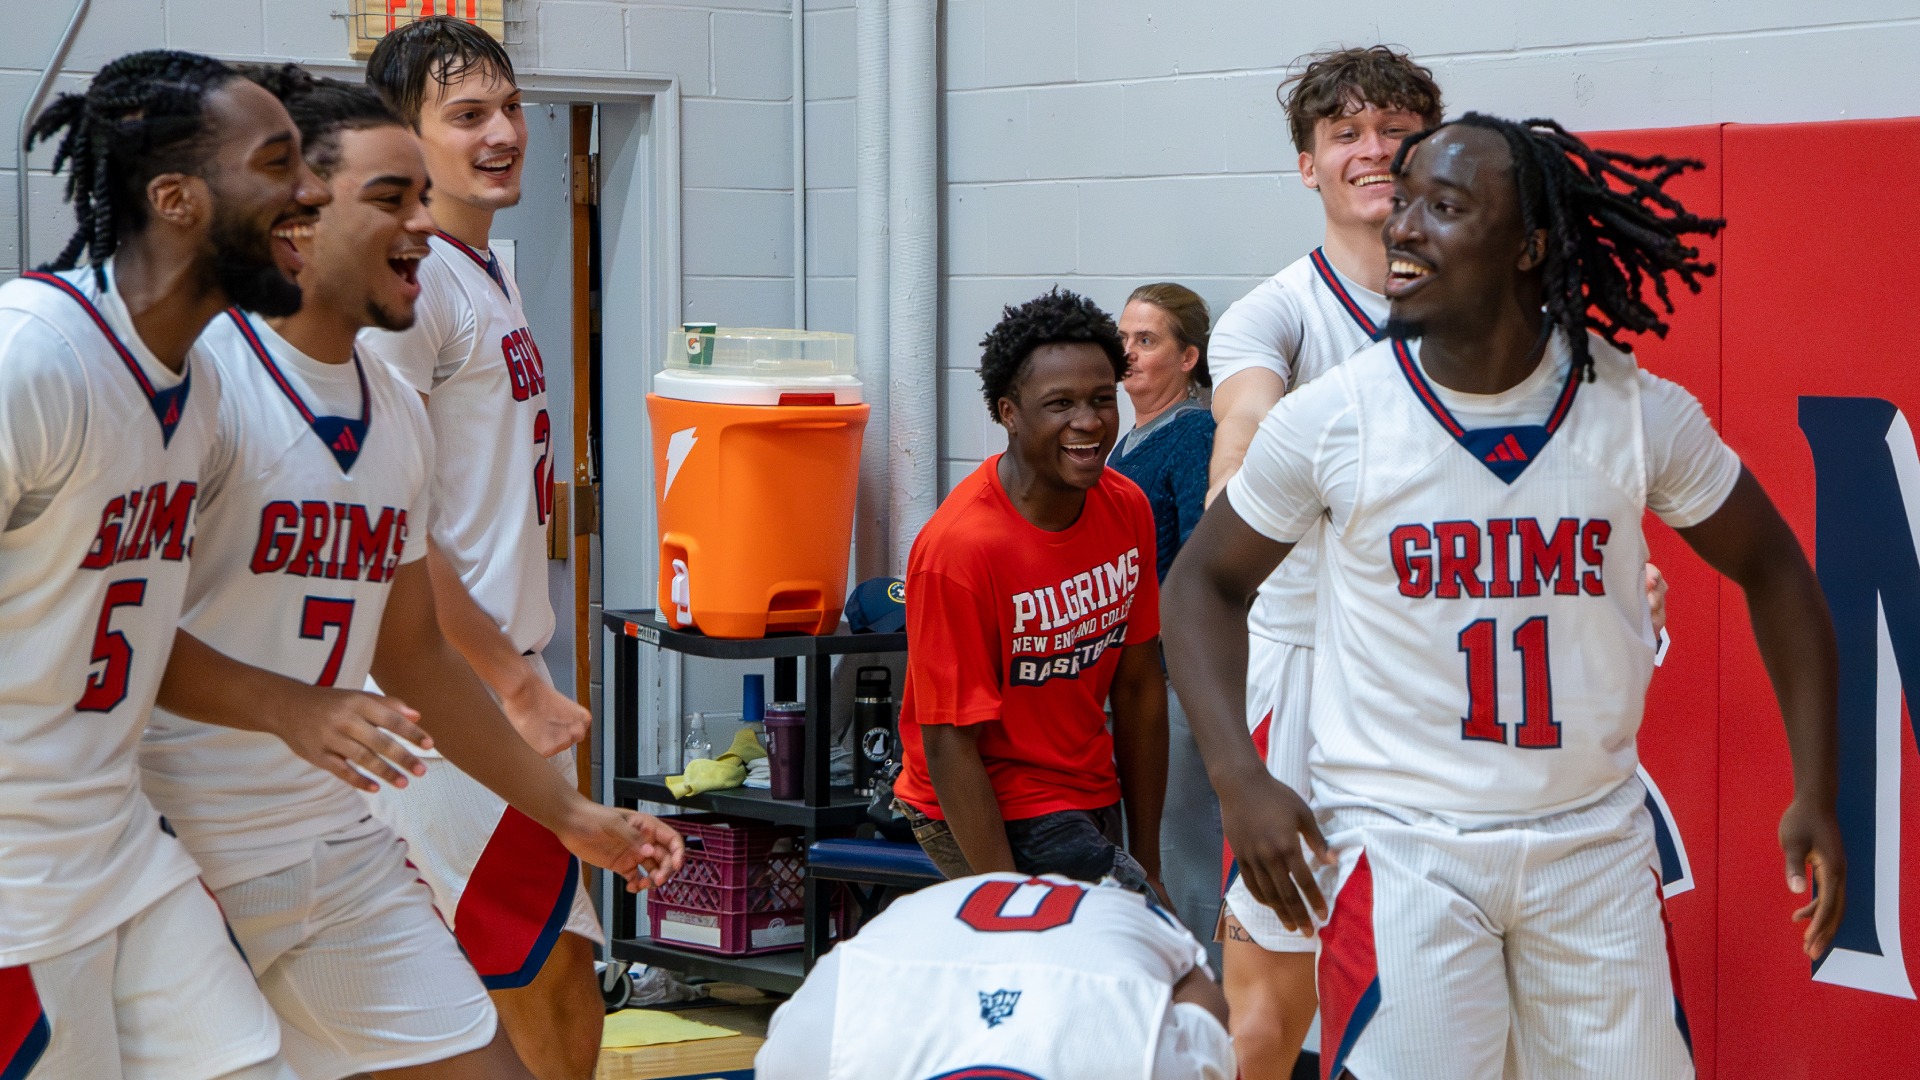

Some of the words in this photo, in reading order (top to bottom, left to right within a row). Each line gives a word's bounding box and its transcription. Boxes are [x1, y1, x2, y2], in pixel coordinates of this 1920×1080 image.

[249, 500, 409, 584] GRIMS
[1388, 516, 1612, 600] GRIMS
[1012, 547, 1140, 634] PILGRIMS
[74, 578, 148, 714] 5
[299, 594, 357, 687] 7
[1011, 636, 1049, 655] NEW
[1457, 615, 1562, 749] 11
[955, 876, 1091, 933] 0
